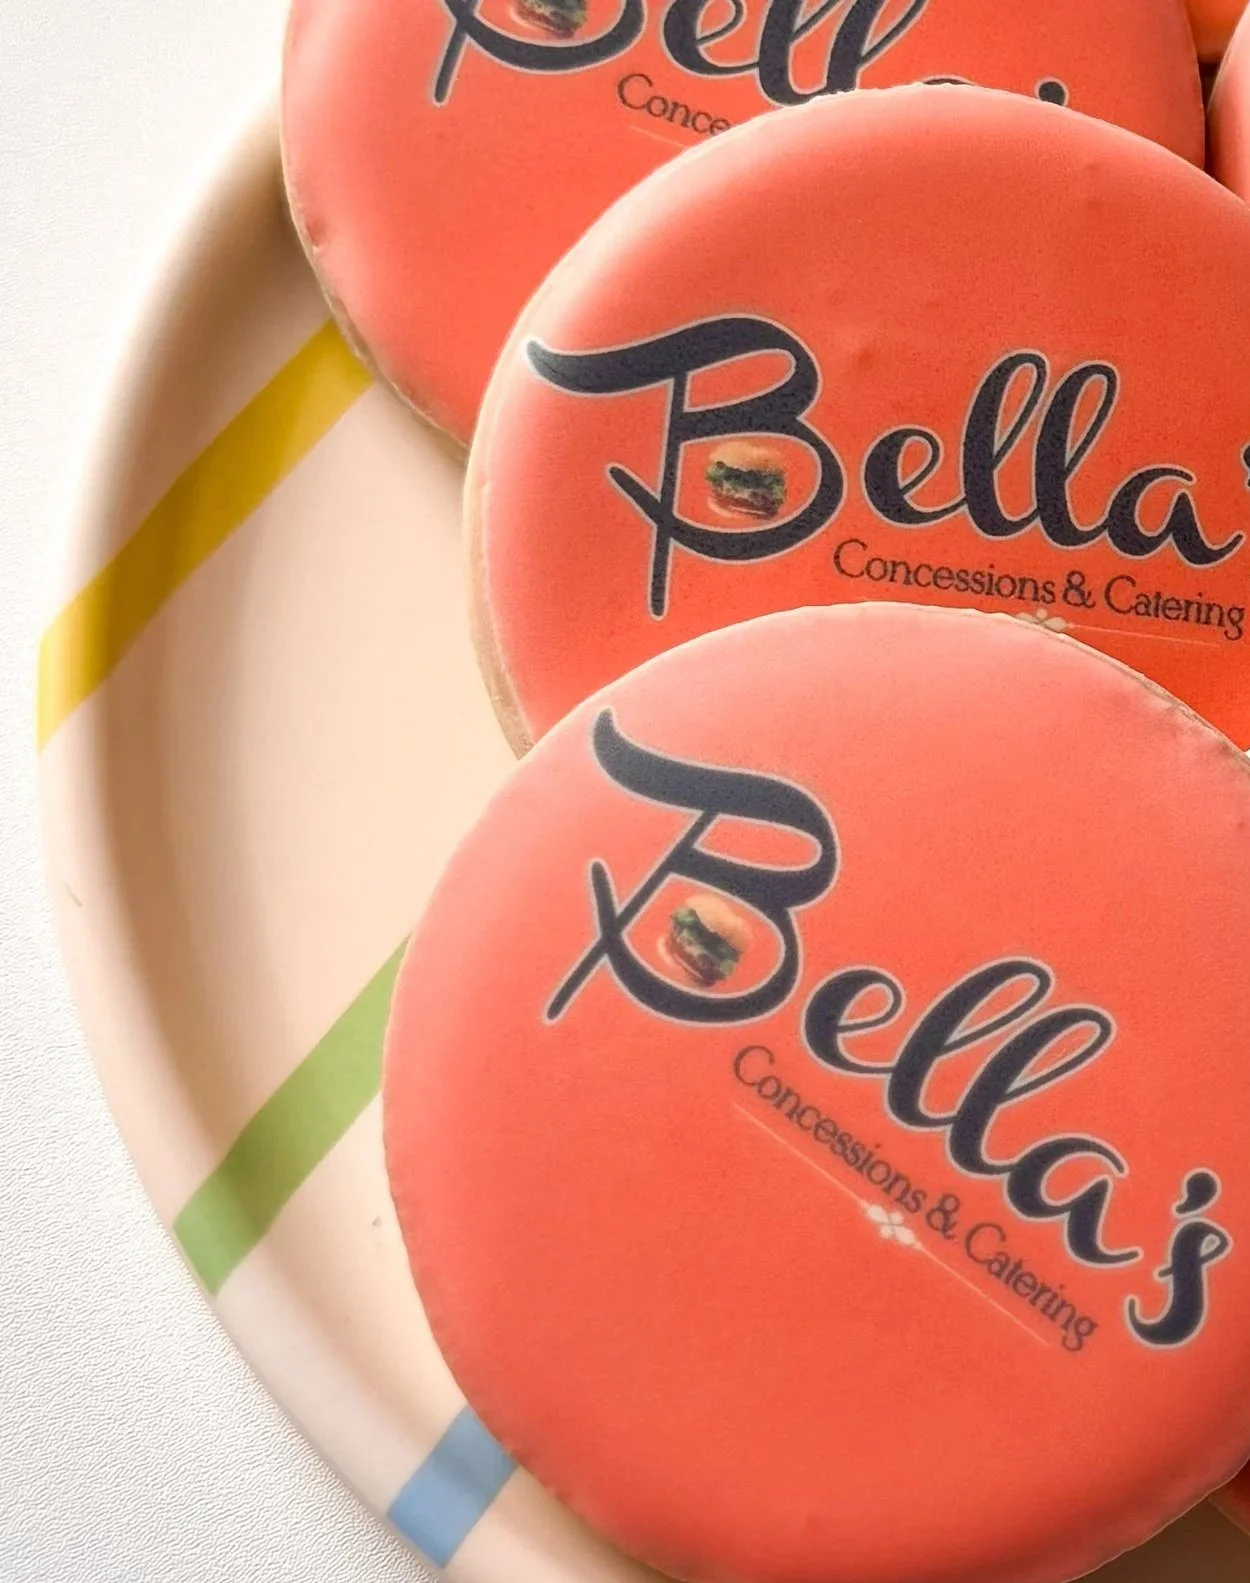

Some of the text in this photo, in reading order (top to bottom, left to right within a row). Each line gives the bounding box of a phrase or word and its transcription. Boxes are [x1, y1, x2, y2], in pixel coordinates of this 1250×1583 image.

[833, 537, 1246, 642] Concessions & Catering
[541, 706, 1232, 1350] Bella's
[733, 1044, 1099, 1352] Concessions & Catering
